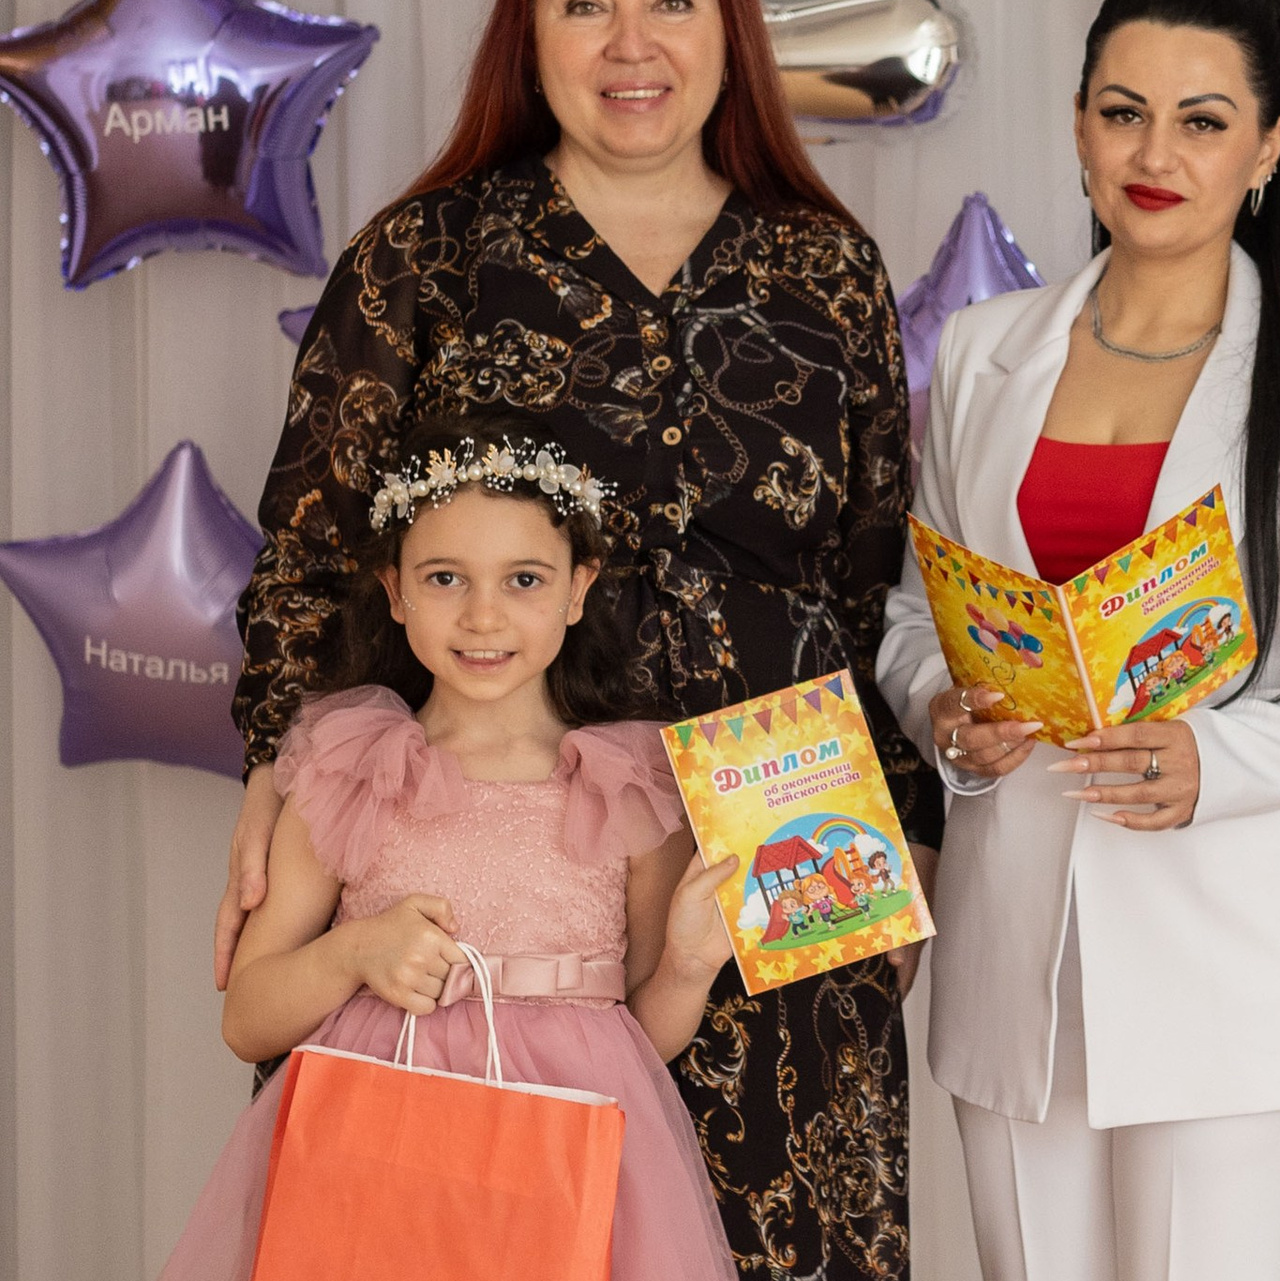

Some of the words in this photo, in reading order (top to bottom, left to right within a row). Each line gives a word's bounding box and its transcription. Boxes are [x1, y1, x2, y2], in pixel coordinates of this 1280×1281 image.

[103, 101, 230, 144] Арман
[1100, 541, 1208, 618] Диплом
[84, 634, 230, 685] Наталья
[713, 738, 841, 794] Диплом
[763, 783, 779, 798] об
[781, 762, 852, 792] окончании
[766, 782, 828, 808] детского
[830, 771, 861, 788] сада
